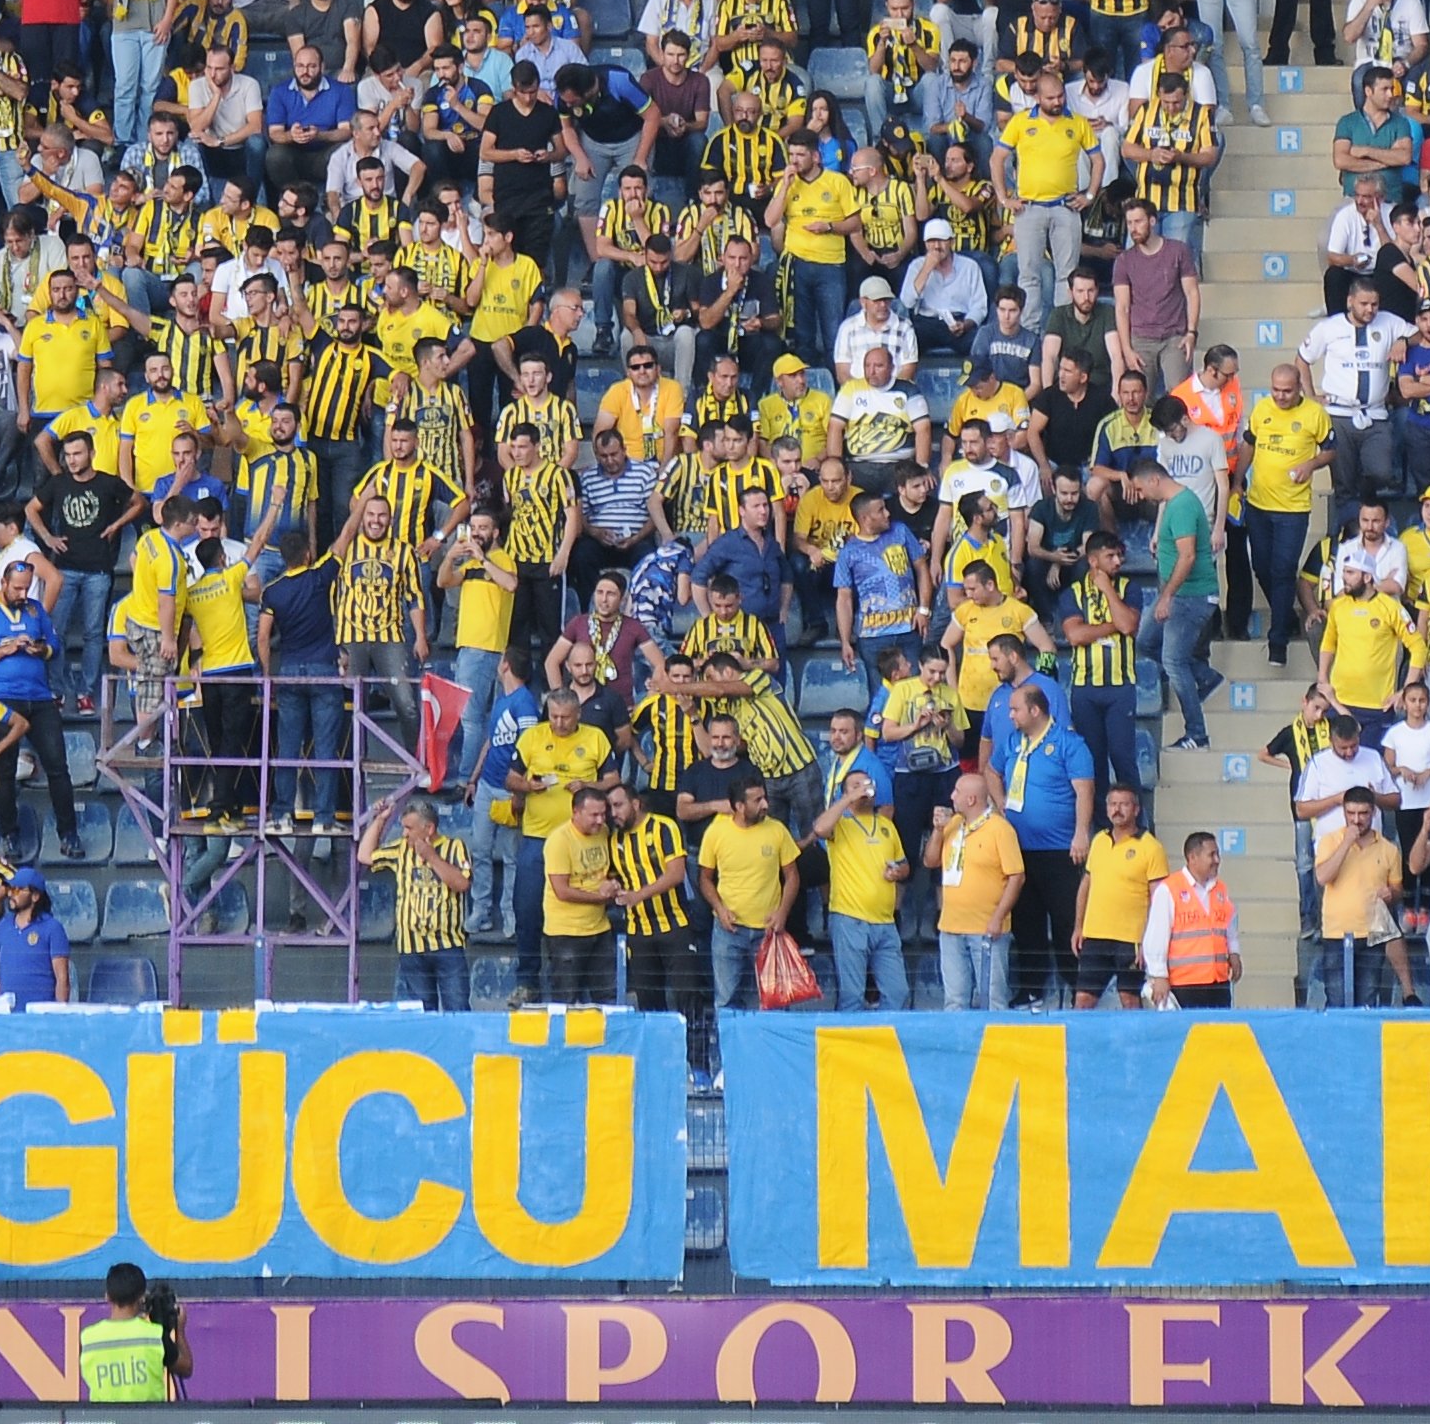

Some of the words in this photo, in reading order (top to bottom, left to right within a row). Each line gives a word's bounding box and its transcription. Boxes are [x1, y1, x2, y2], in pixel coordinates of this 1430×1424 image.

[1281, 70, 1299, 91] T
[1281, 130, 1299, 150] R
[1273, 192, 1292, 212] P
[1265, 256, 1285, 276] O
[1258, 324, 1278, 344] N
[1234, 686, 1254, 707] H
[1228, 757, 1247, 778] G
[1223, 831, 1240, 851] F
[96, 1355, 149, 1390] POLİS
